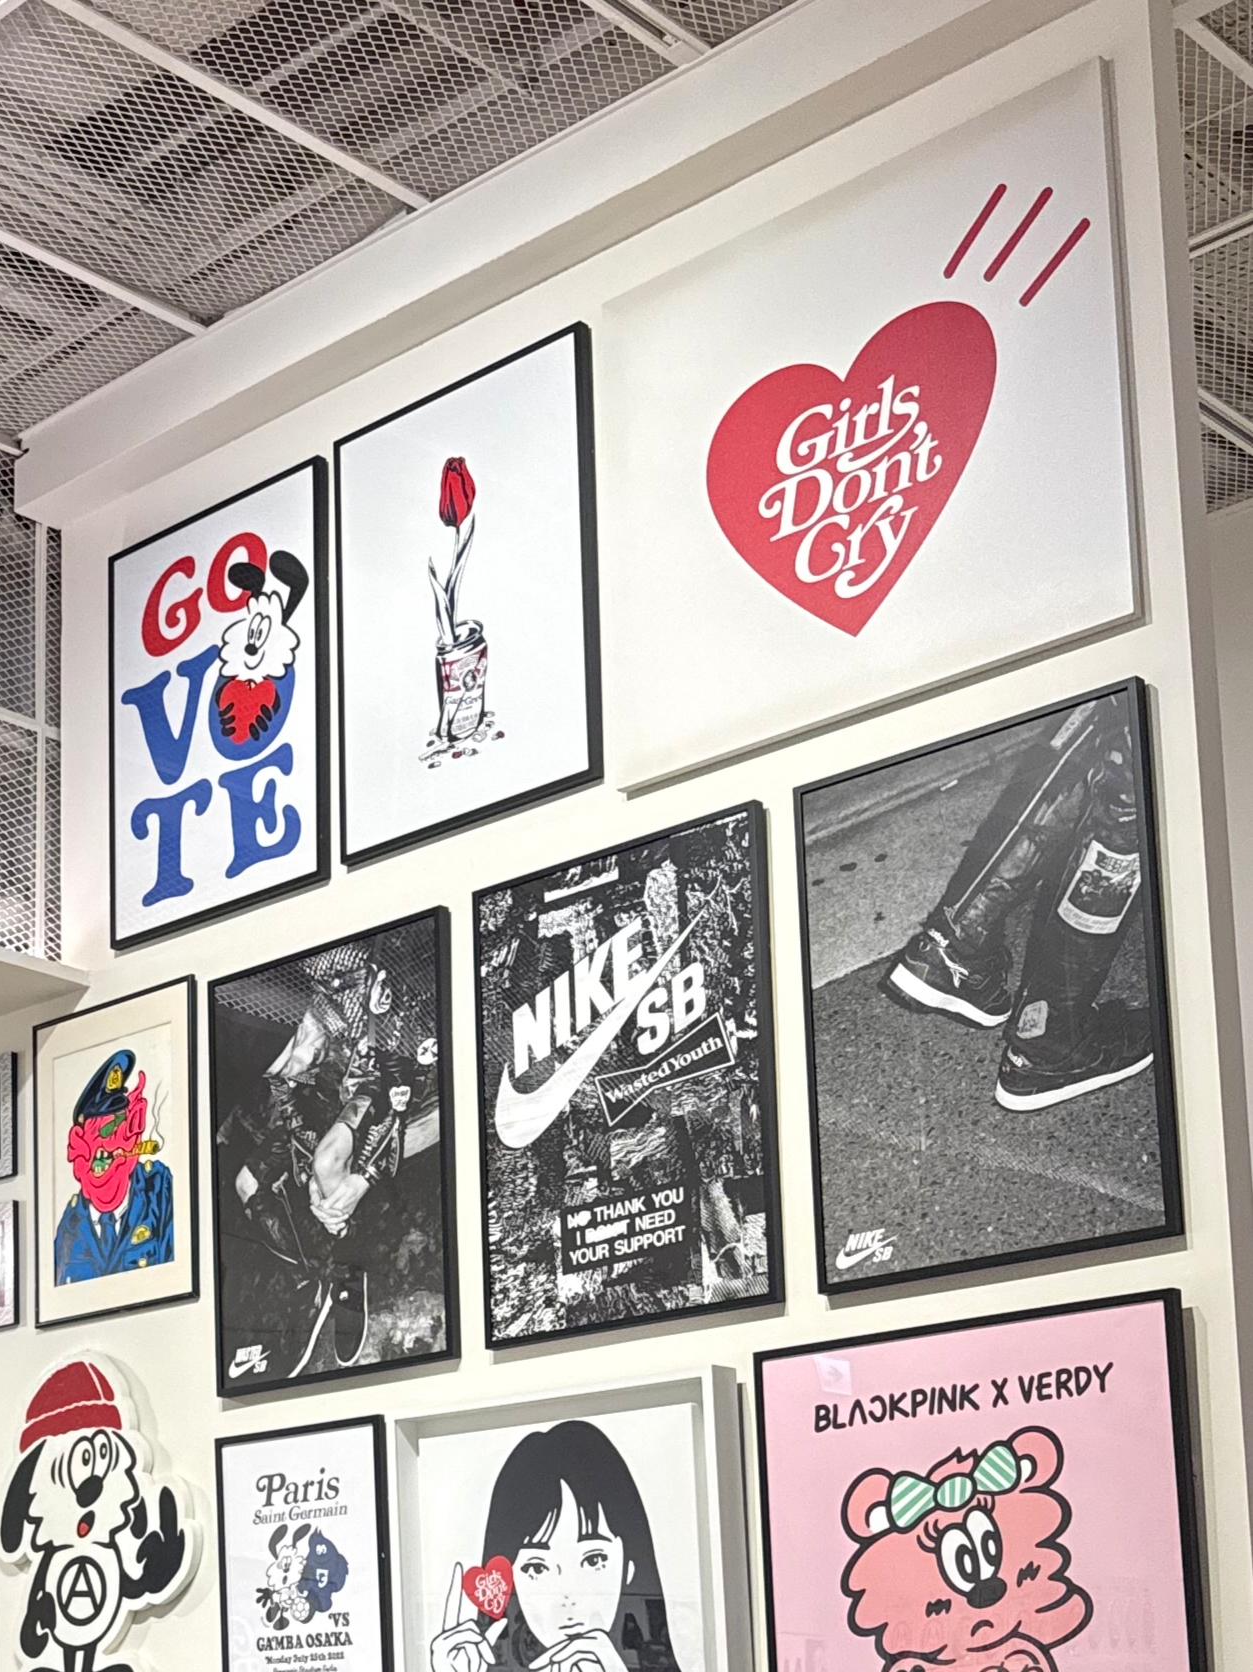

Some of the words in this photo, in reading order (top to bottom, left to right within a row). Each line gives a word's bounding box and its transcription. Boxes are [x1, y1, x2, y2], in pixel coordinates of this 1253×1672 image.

[775, 375, 920, 477] Girls
[758, 420, 943, 543] Don't
[795, 494, 918, 600] Cry
[141, 532, 268, 657] GO
[512, 918, 649, 1079] NIKE
[636, 961, 707, 1056] SB
[604, 1064, 672, 1107] Wasted
[669, 1034, 724, 1075] Youth
[593, 1196, 647, 1222] THANK
[651, 1187, 685, 1209] YOU
[635, 1209, 676, 1232] NEED
[569, 1244, 609, 1265] YOUR
[614, 1225, 686, 1256] SUPPORT
[845, 1228, 885, 1252] NIKE
[872, 1246, 893, 1262] SB
[992, 1378, 1009, 1409] X
[1018, 1361, 1114, 1405] VERDY
[256, 1467, 340, 1508] Paris
[252, 1509, 286, 1525] Saint
[288, 1500, 348, 1521] Germain
[475, 1570, 503, 1589] Girls
[328, 1612, 350, 1628] VS
[256, 1634, 304, 1652] GAMBA
[305, 1631, 353, 1648] OSAKA
